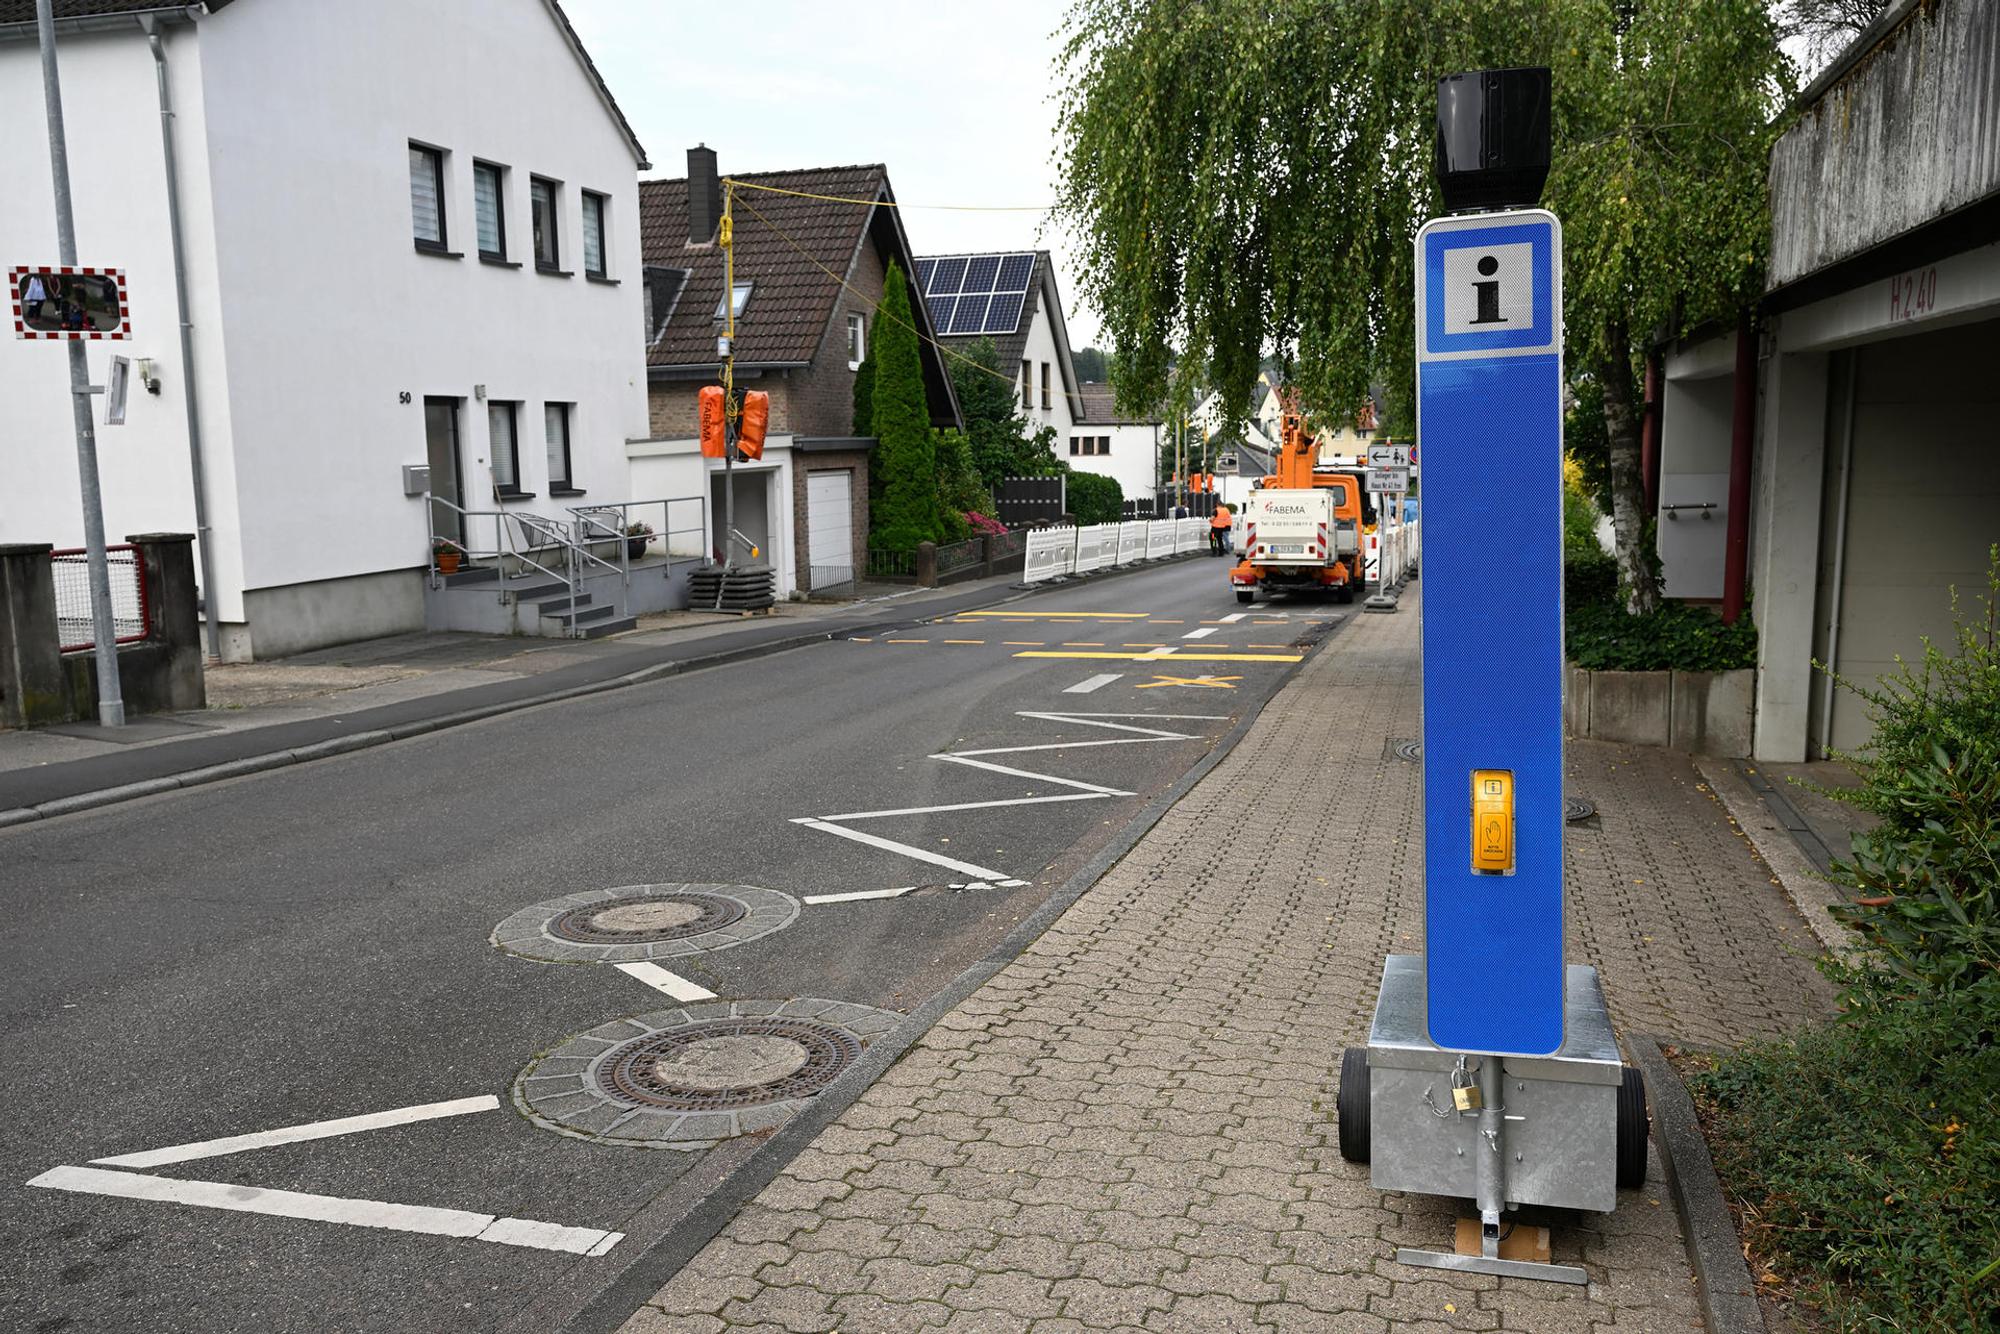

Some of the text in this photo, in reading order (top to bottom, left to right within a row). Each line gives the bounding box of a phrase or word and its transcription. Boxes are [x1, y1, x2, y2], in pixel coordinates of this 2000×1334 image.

[1469, 256, 1508, 324] i
[399, 391, 411, 404] 50
[703, 401, 712, 441] FABEMA
[1269, 505, 1305, 514] FABEMA
